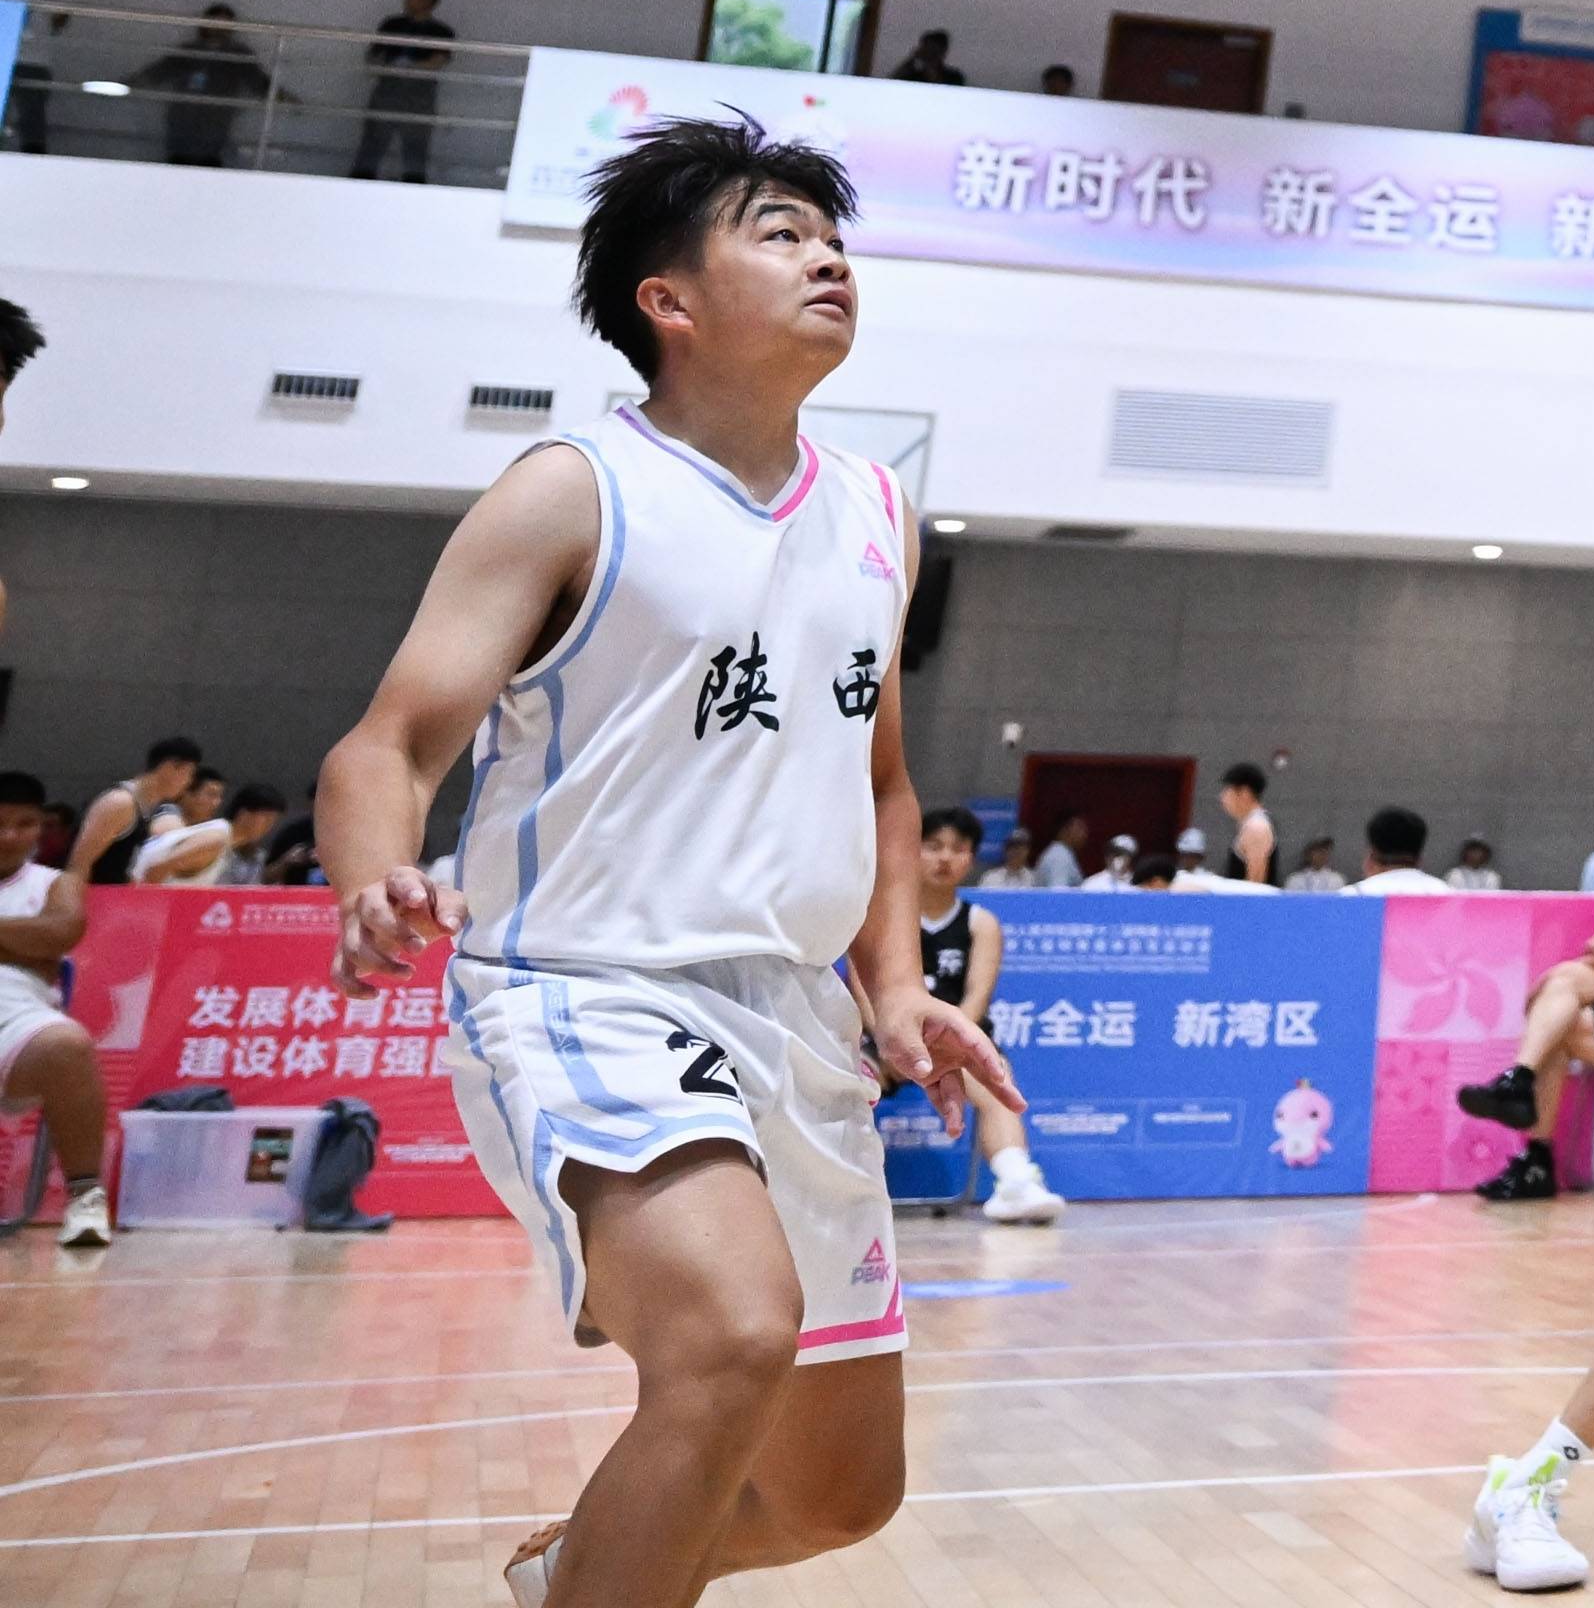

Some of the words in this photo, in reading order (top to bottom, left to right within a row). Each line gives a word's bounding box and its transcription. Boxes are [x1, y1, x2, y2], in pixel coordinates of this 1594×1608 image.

[955, 139, 1211, 230] 新时代
[1263, 167, 1500, 253] 新全运
[694, 630, 882, 741] 陕西
[188, 985, 451, 1029] 发展体育运
[989, 999, 1137, 1048] 新全运
[1172, 998, 1321, 1048] 新湾区
[851, 1264, 891, 1286] PEAK
